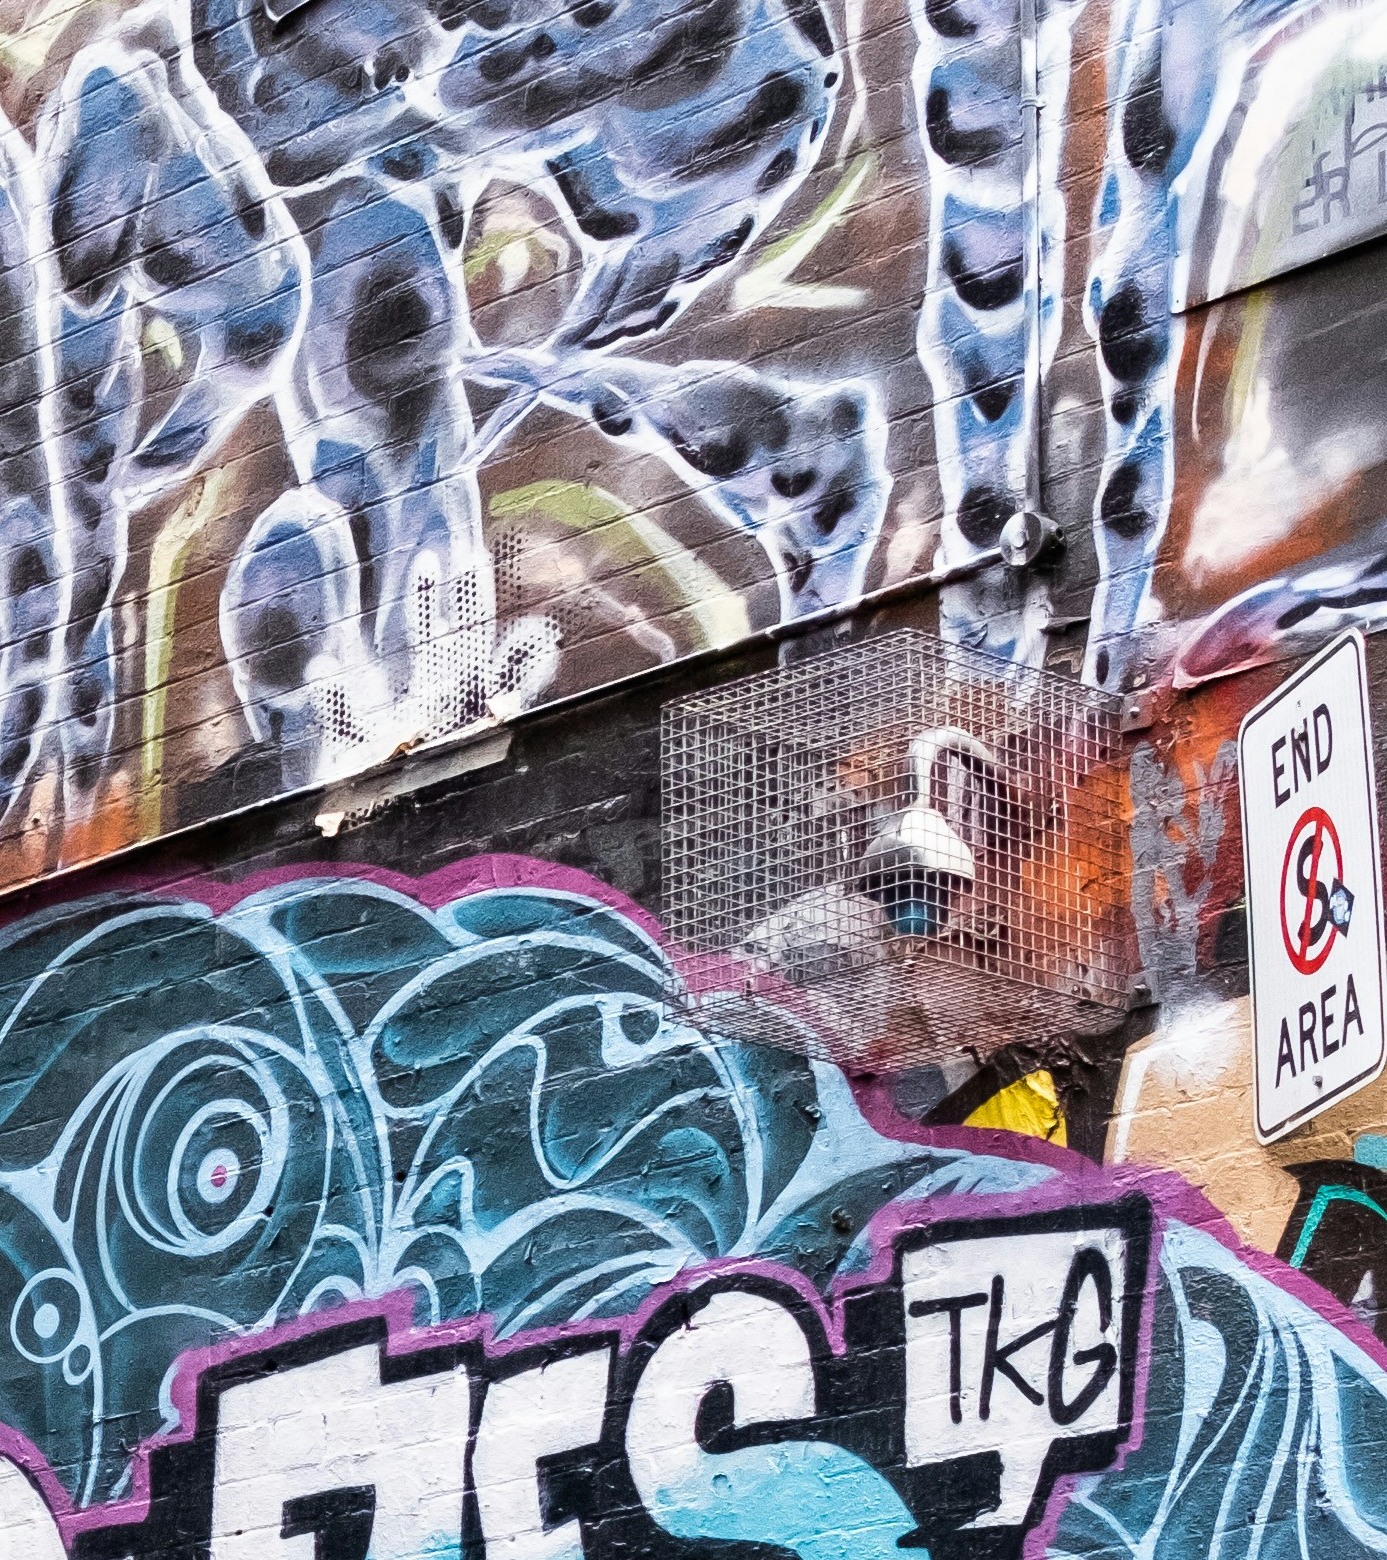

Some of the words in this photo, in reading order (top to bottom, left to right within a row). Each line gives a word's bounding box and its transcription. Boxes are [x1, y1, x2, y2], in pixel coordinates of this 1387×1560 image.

[1270, 702, 1334, 810] END
[1273, 980, 1365, 1090] AREA
[908, 1246, 1116, 1427] TKG
